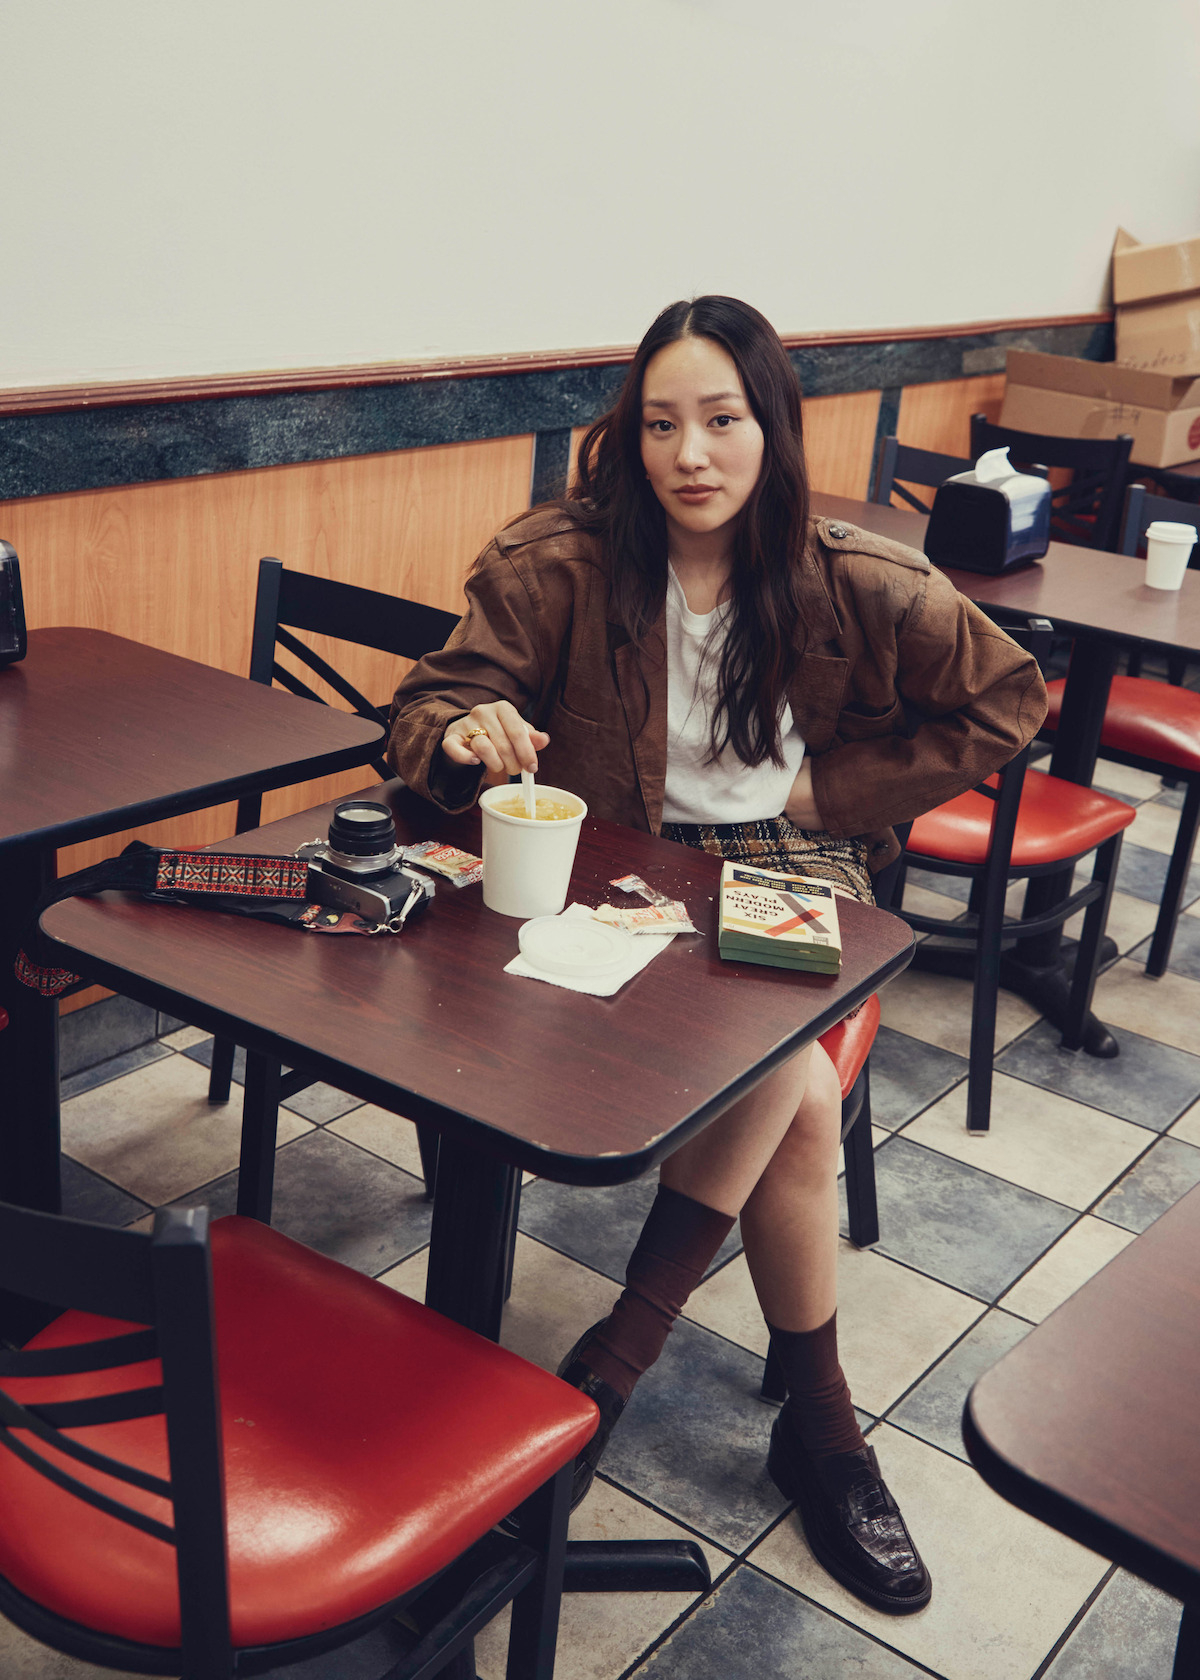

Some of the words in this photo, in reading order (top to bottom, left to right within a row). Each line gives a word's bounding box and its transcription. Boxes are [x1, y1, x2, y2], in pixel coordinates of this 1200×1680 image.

[433, 847, 460, 861] Zesta
[726, 895, 784, 911] MODERN
[734, 890, 777, 904] PLAYS
[733, 903, 778, 917] GREAT
[744, 911, 766, 921] SIX
